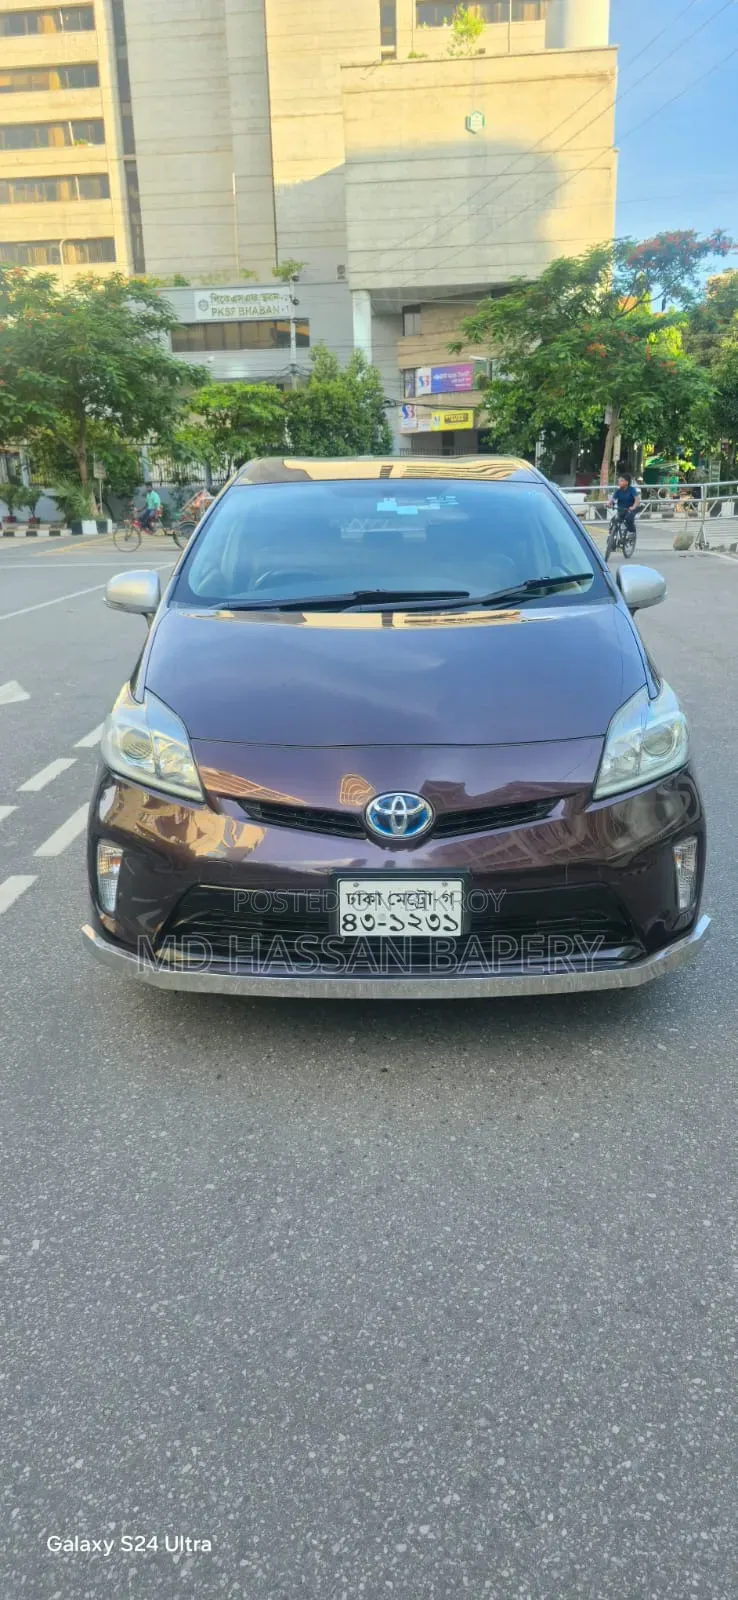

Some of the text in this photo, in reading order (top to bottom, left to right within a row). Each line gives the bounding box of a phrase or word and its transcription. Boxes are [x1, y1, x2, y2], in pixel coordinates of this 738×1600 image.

[211, 307, 236, 316] PKSF
[346, 892, 382, 906] ঢাকা
[342, 913, 459, 932] ৪৩-১২৩১
